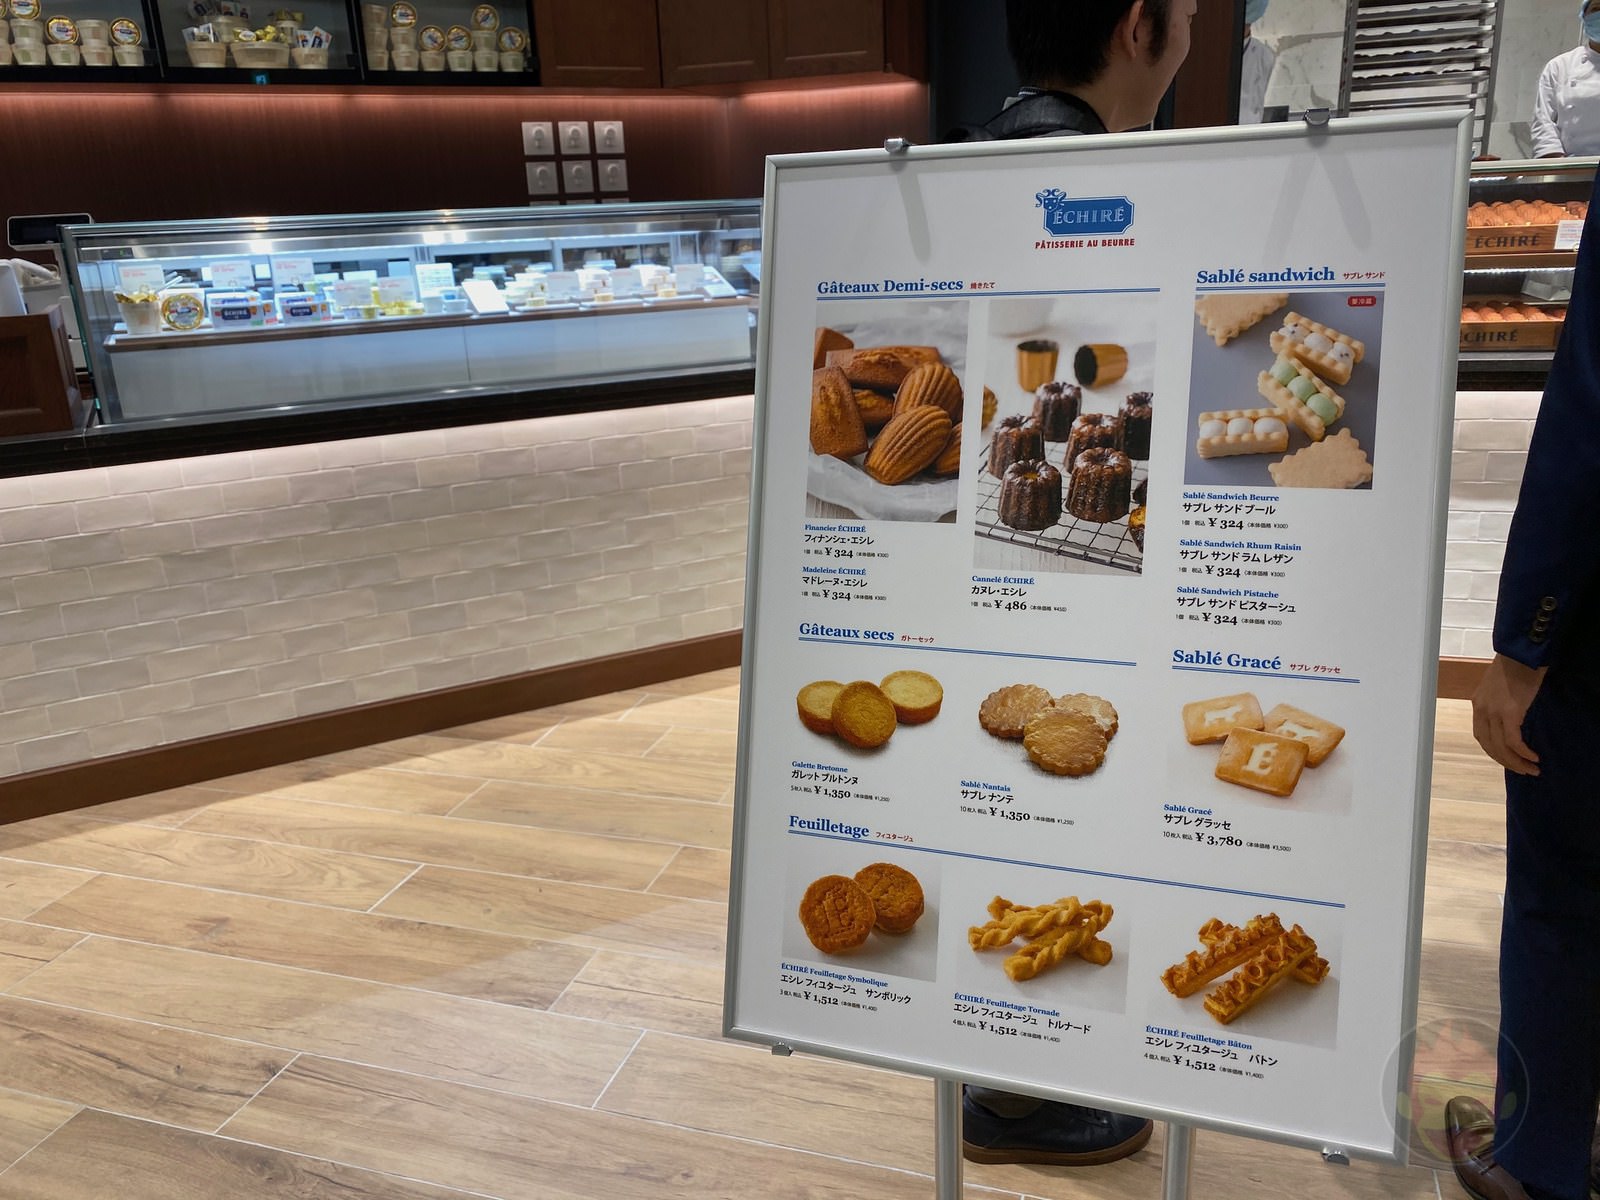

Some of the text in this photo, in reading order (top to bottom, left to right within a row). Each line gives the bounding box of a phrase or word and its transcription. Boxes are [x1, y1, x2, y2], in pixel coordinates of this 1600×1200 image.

[1053, 206, 1124, 224] ÉCHIRÉ
[1035, 238, 1135, 249] PÂTISSERIE AU BEURRE
[1196, 267, 1335, 284] Sablé sandwich
[817, 278, 963, 294] Gâteaux Demi-secs
[1460, 328, 1518, 344] CHIRÉ
[1183, 492, 1206, 500] Sablé
[1207, 493, 1248, 501] Sandwich
[1183, 502, 1276, 515] サブレ サンド ブール
[804, 524, 866, 532] Financier ÉCHIRÉ
[804, 534, 875, 545] フィナンシェ・エシレ
[1180, 539, 1301, 551] Sablé Sandwich Rhum Raisin
[1180, 549, 1209, 560] サブレ
[1211, 551, 1240, 562] サンド
[802, 566, 867, 575] Madeleine ÉCHIRÉ
[802, 576, 868, 587] マドレーヌ・エシレ
[972, 575, 1035, 585] Cannelé ÉCHIRÉ
[971, 585, 1027, 597] カヌレ・エシレ
[1177, 586, 1279, 598] Sablé Sandwich Pistache
[1177, 597, 1205, 607] サブレ
[1208, 598, 1237, 609] サンド
[799, 622, 895, 641] Gâteaux secs
[1172, 649, 1281, 670] Sablé Gracé
[791, 760, 848, 773] Galette Bretonne
[791, 769, 858, 785] ガレット ブルトンヌ
[960, 780, 1011, 792] Sablé Nantais
[961, 789, 1014, 804] サブレ ナンテ
[1164, 803, 1212, 815] Sablé Gracé
[789, 815, 870, 839] Feuilletage
[1164, 813, 1231, 830] サブレ グラッセ
[780, 974, 803, 985] エシレ
[781, 962, 888, 987] ÉCHIRÉ Feuilletage Symbolique
[954, 992, 1060, 1017] ÉCHIRÉ Feuilletage Tornade
[954, 1003, 979, 1014] エシレ
[1048, 1018, 1091, 1034] トルナード
[1145, 1036, 1173, 1048] エシレ
[1146, 1025, 1252, 1050] ÉCHIRÉ Feuilletage Bâton
